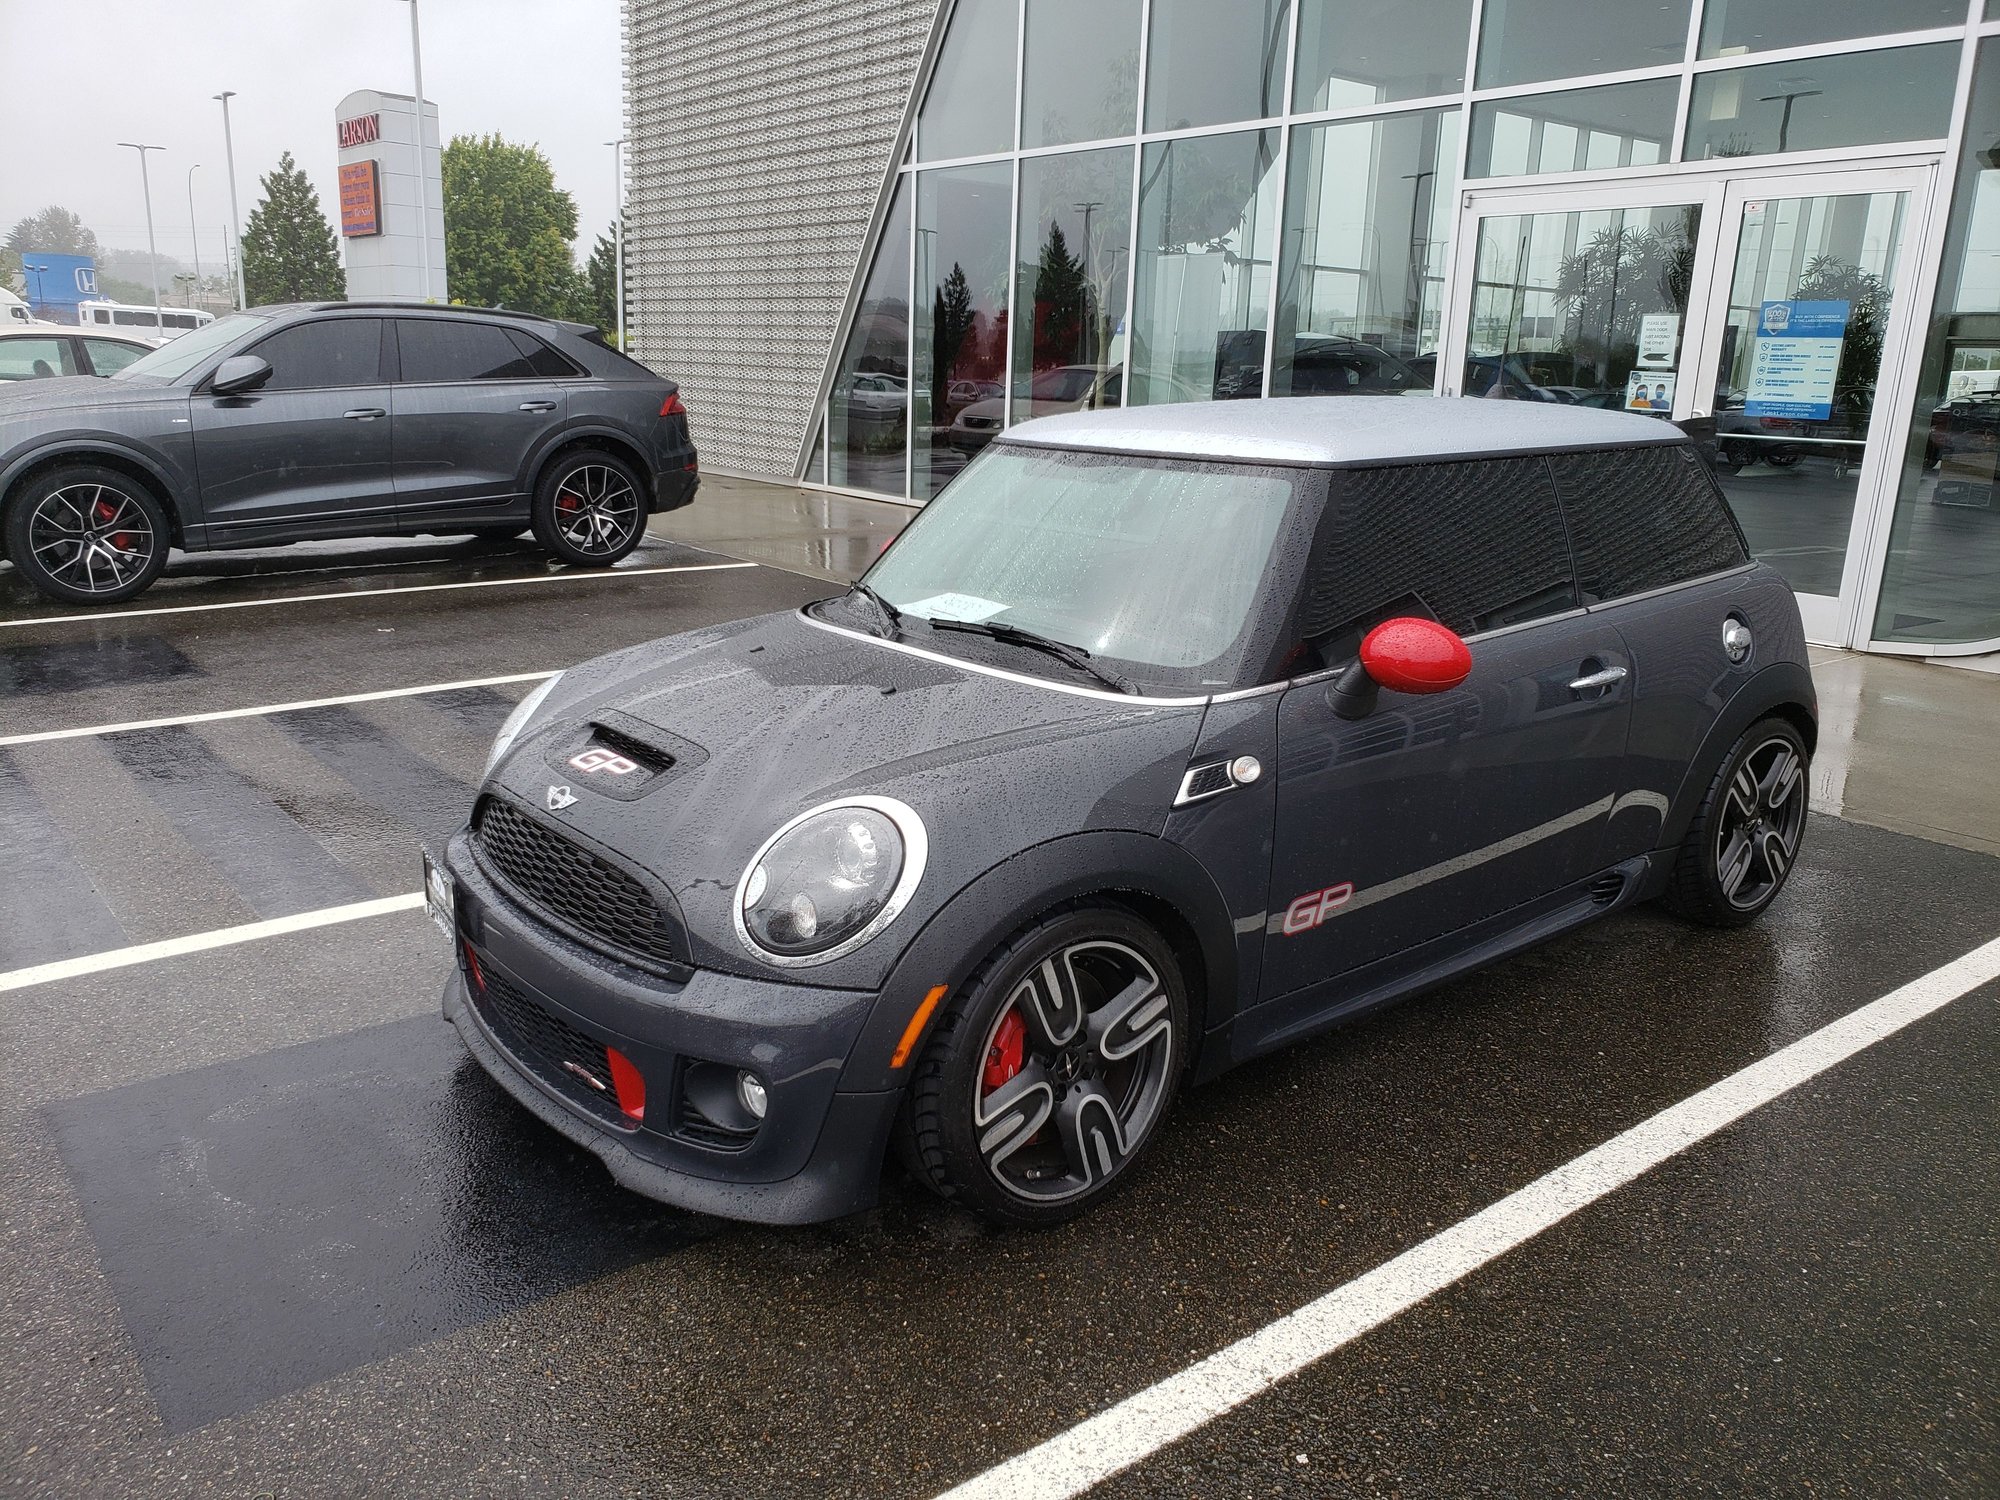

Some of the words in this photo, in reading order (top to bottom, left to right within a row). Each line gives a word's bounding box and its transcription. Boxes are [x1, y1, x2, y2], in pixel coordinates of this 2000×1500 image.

[337, 114, 380, 148] LARSON
[567, 748, 638, 776] GP
[1283, 881, 1355, 937] GP
